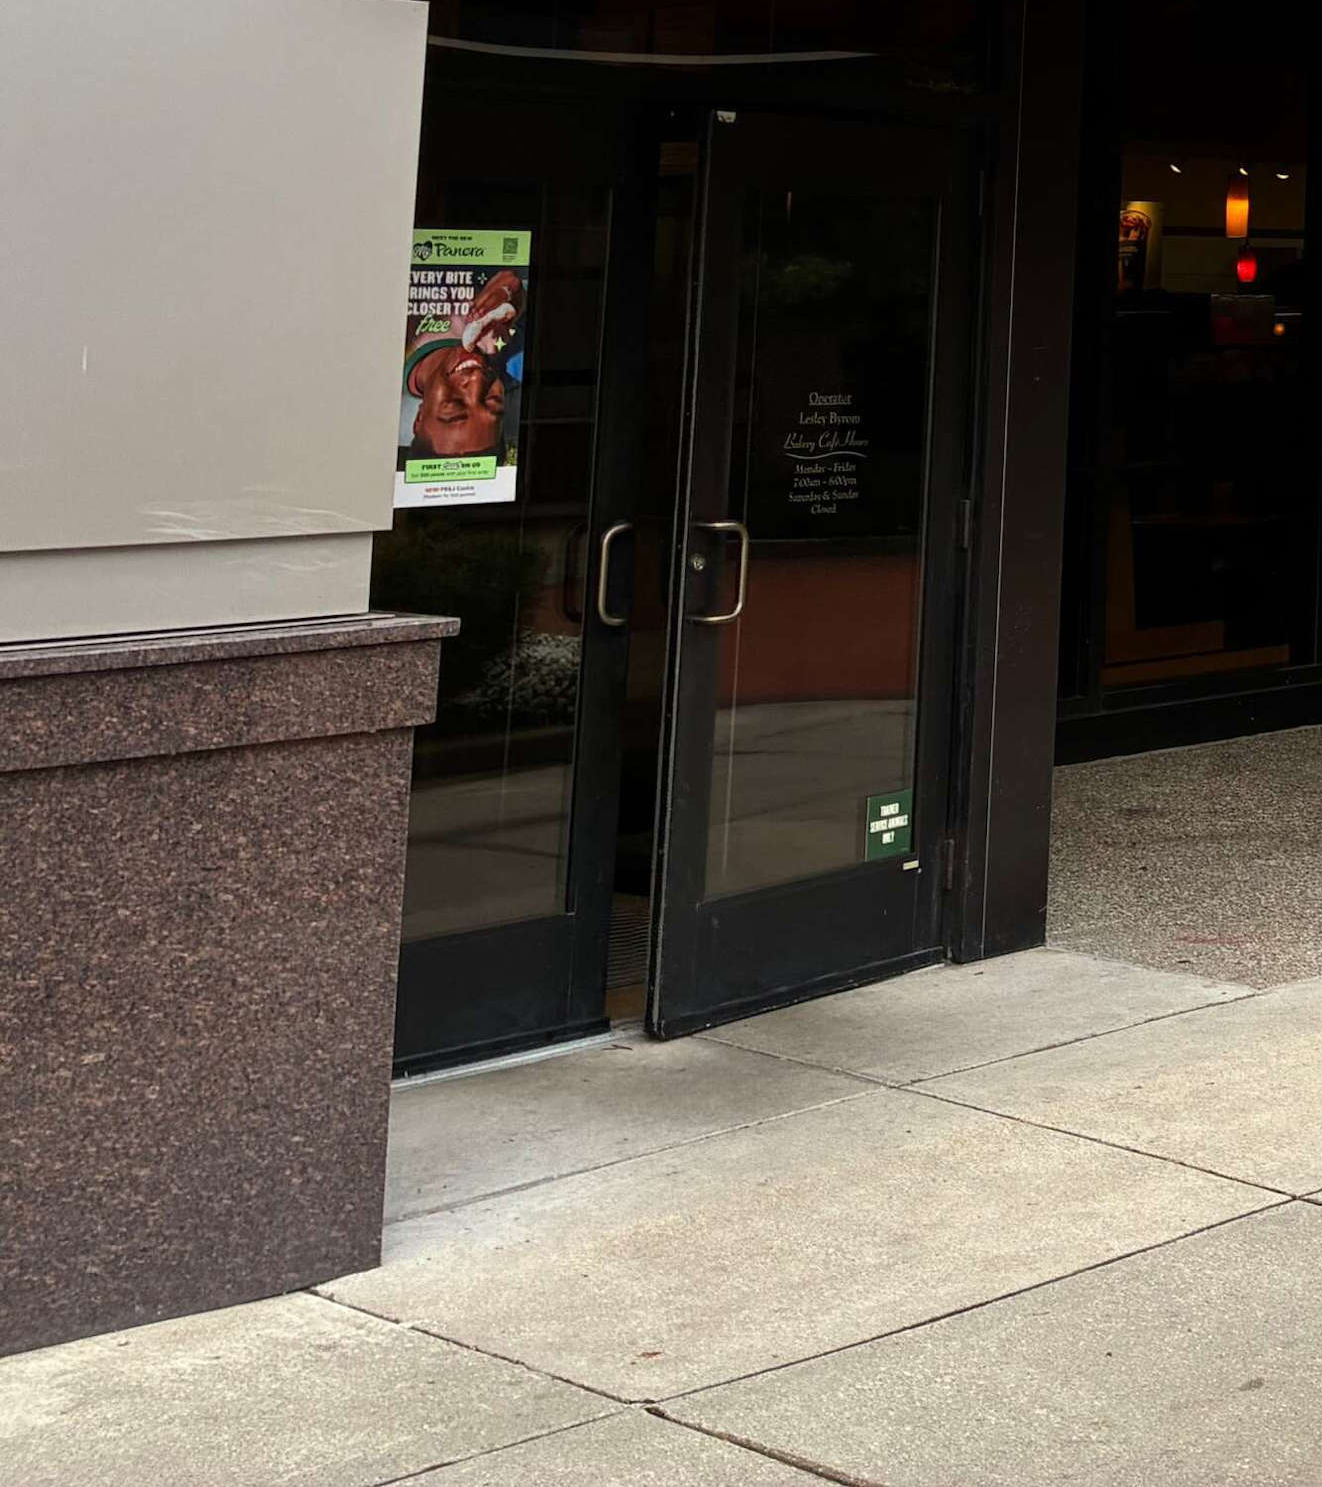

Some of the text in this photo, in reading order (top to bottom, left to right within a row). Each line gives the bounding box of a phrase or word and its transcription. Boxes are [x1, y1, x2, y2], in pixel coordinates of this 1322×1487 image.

[434, 243, 484, 258] Panera
[411, 271, 474, 285] VERY BITE
[409, 286, 475, 300] RINGS YOU
[453, 302, 470, 316] TO
[416, 313, 451, 336] free
